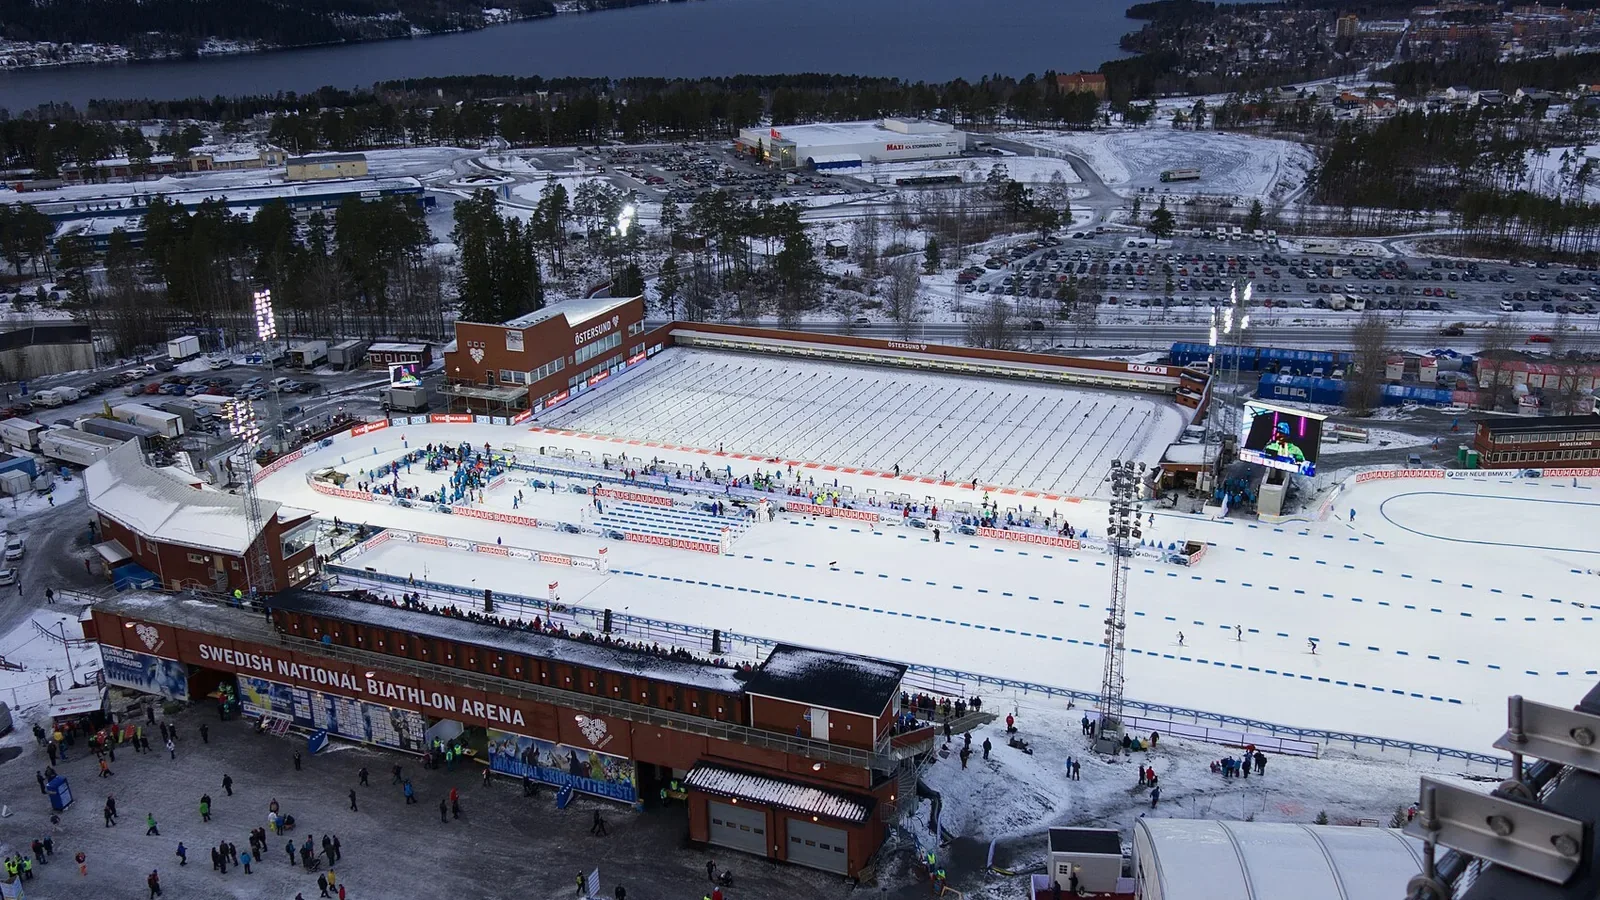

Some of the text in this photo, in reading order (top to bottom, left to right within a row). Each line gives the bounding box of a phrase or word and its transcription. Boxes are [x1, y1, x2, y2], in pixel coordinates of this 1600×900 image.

[574, 320, 612, 346] ÖSTERSUND
[887, 341, 920, 350] ÖSTERSUND
[1397, 469, 1445, 478] BAUHAUS
[630, 493, 672, 507] BAUHAUS
[454, 506, 537, 527] BAUHAUS BAUHAUS
[787, 502, 879, 522] BAUHAUS BAUHAUS
[625, 532, 719, 554] BAUHAUS BAUHAUS
[976, 527, 1079, 549] BAUHAUS BAUHAUS
[198, 643, 273, 673] SWEDISH
[277, 659, 363, 691] NATIONAL
[366, 678, 456, 712] BIATHLON
[461, 698, 526, 727] ARENA
[492, 757, 539, 778] MAXIMAL
